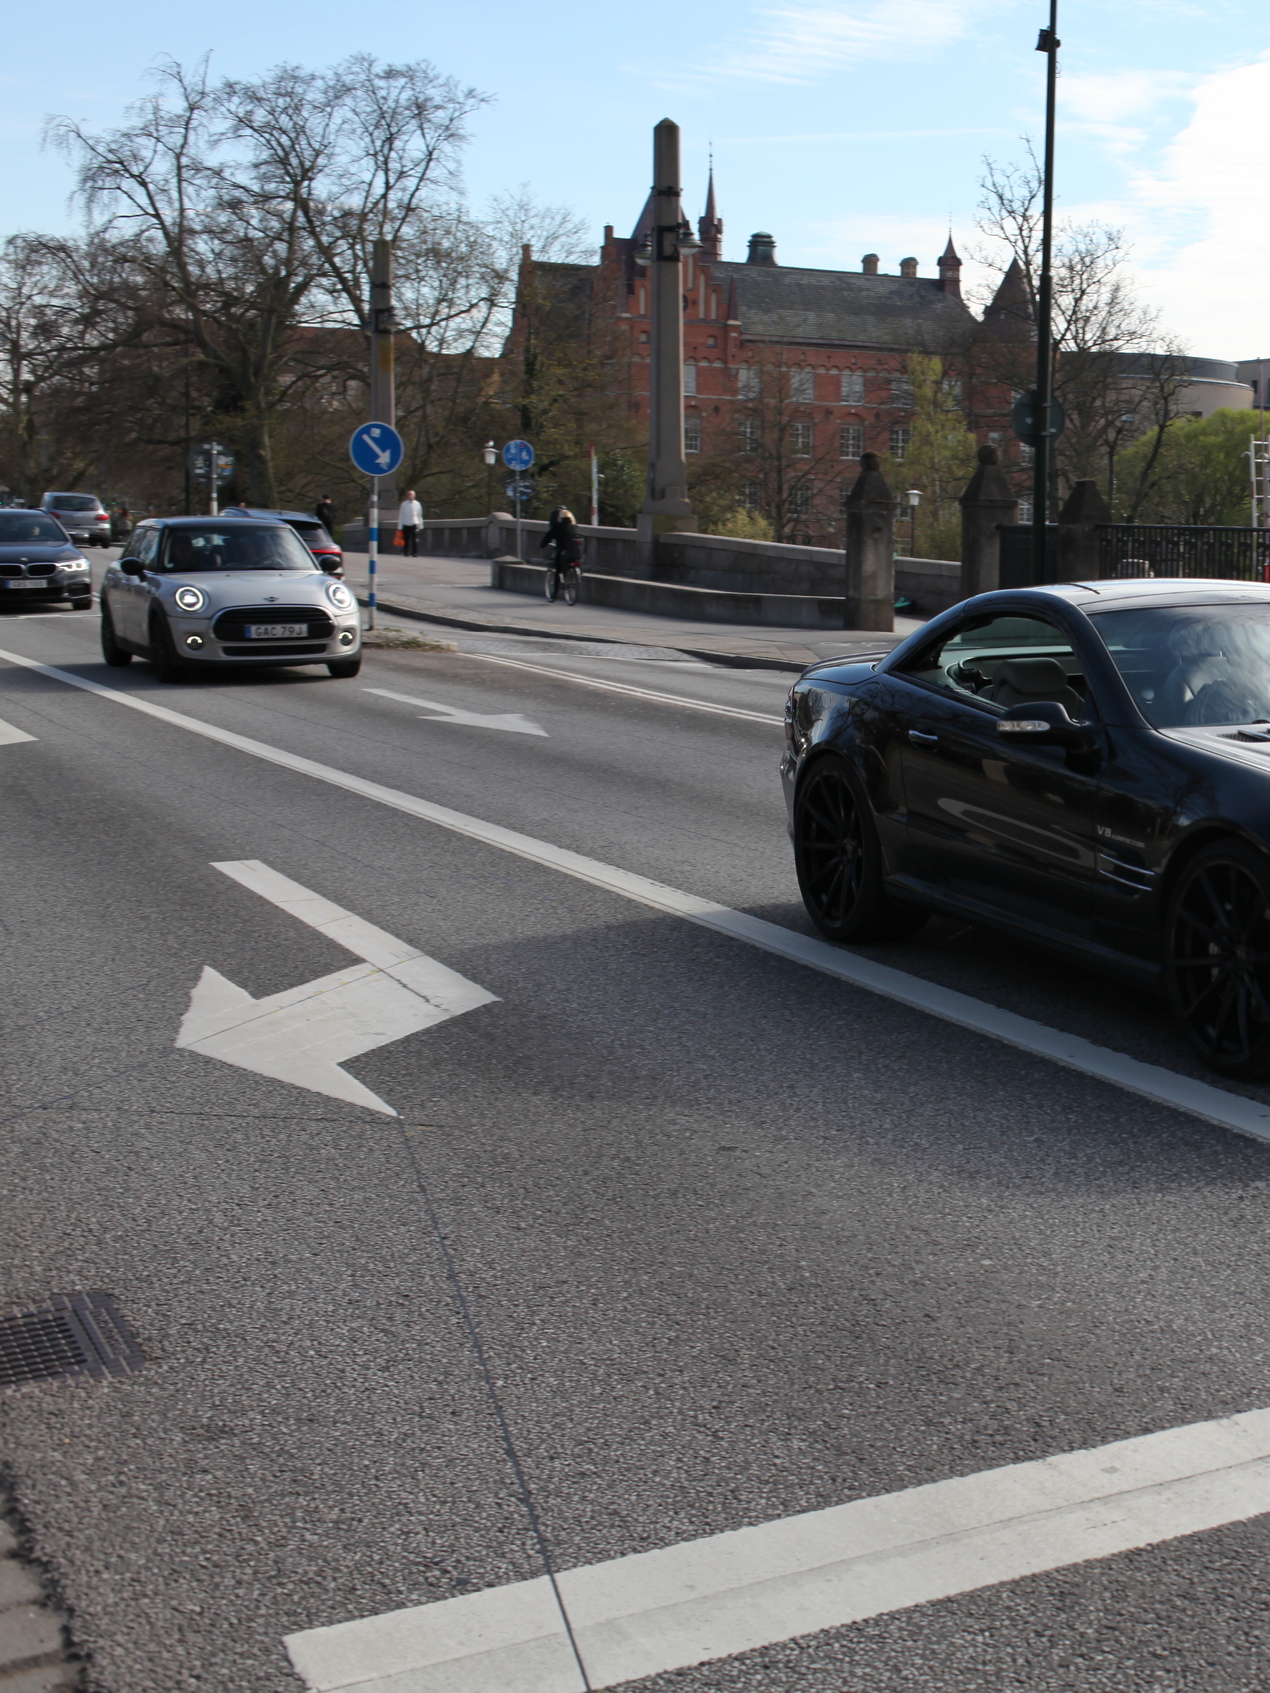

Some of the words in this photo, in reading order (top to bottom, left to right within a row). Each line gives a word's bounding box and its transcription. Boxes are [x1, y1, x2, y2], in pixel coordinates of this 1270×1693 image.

[254, 626, 278, 637] GAC
[280, 625, 303, 637] 79J
[1096, 824, 1112, 838] V8
